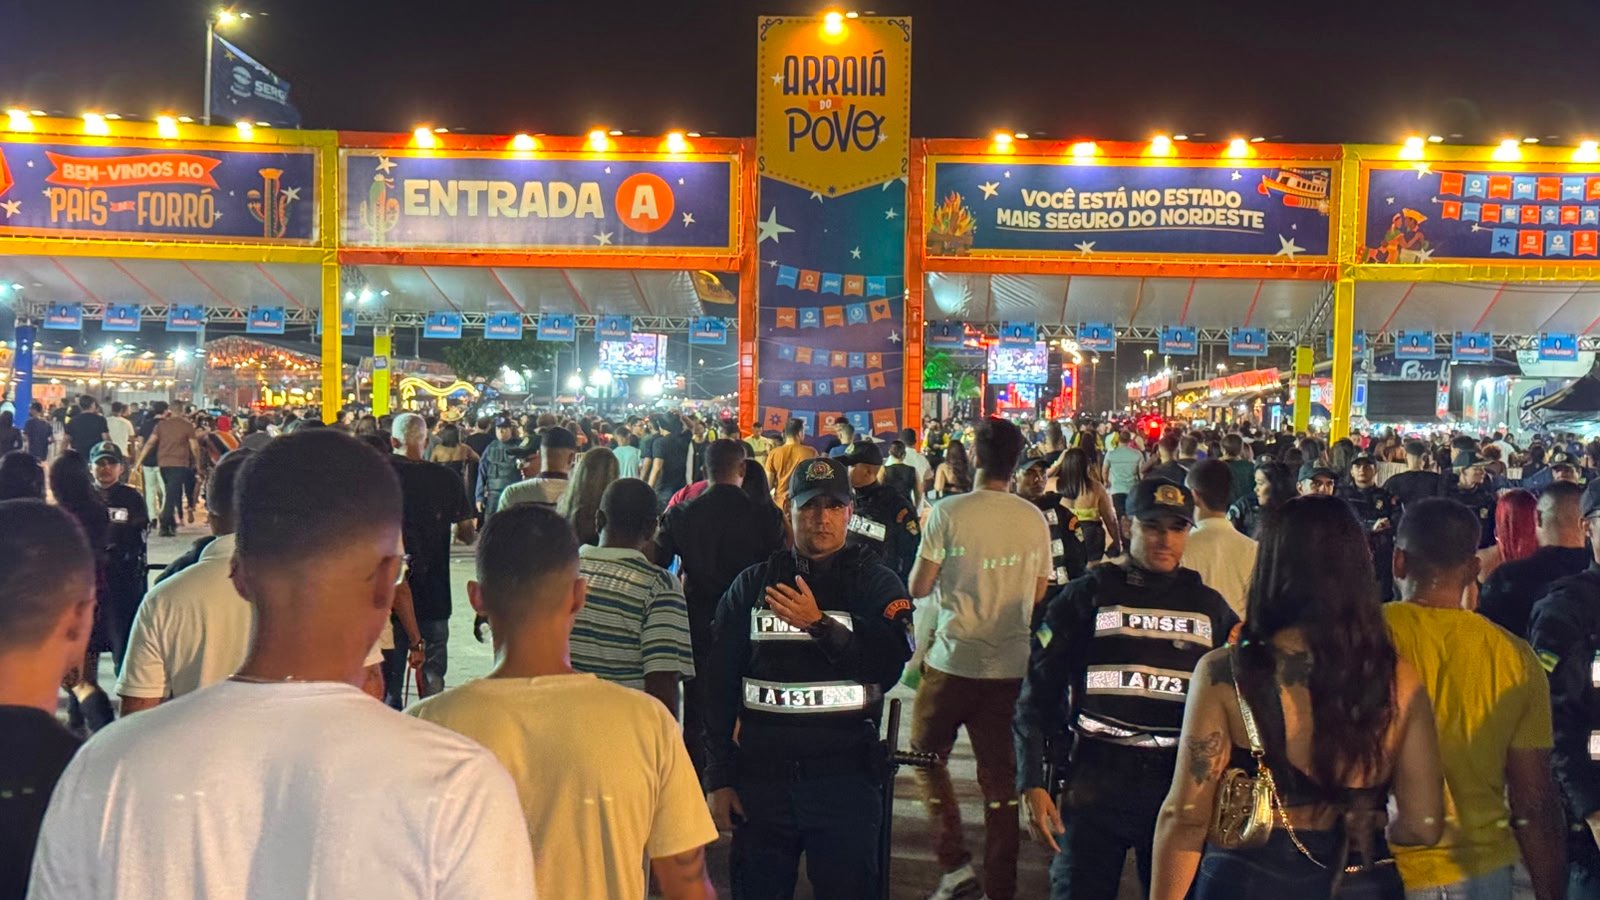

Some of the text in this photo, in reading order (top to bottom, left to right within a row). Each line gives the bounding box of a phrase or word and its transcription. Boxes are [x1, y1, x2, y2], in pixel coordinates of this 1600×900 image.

[783, 49, 886, 96] ARRAIÁ
[819, 99, 832, 110] DO
[784, 104, 886, 152] POVO
[62, 161, 204, 181] BEM-VINDOS AO
[51, 182, 215, 229] PAÍS FORRÓ
[403, 179, 658, 220] ENTRADA A
[1021, 186, 1242, 210] VOCÊ ESTÁ NO ESTADO
[996, 207, 1265, 229] MAIS SEGURO DO NORDESTE
[1129, 614, 1188, 633] PMSE
[1129, 672, 1144, 688] A
[765, 686, 816, 706] A 131
